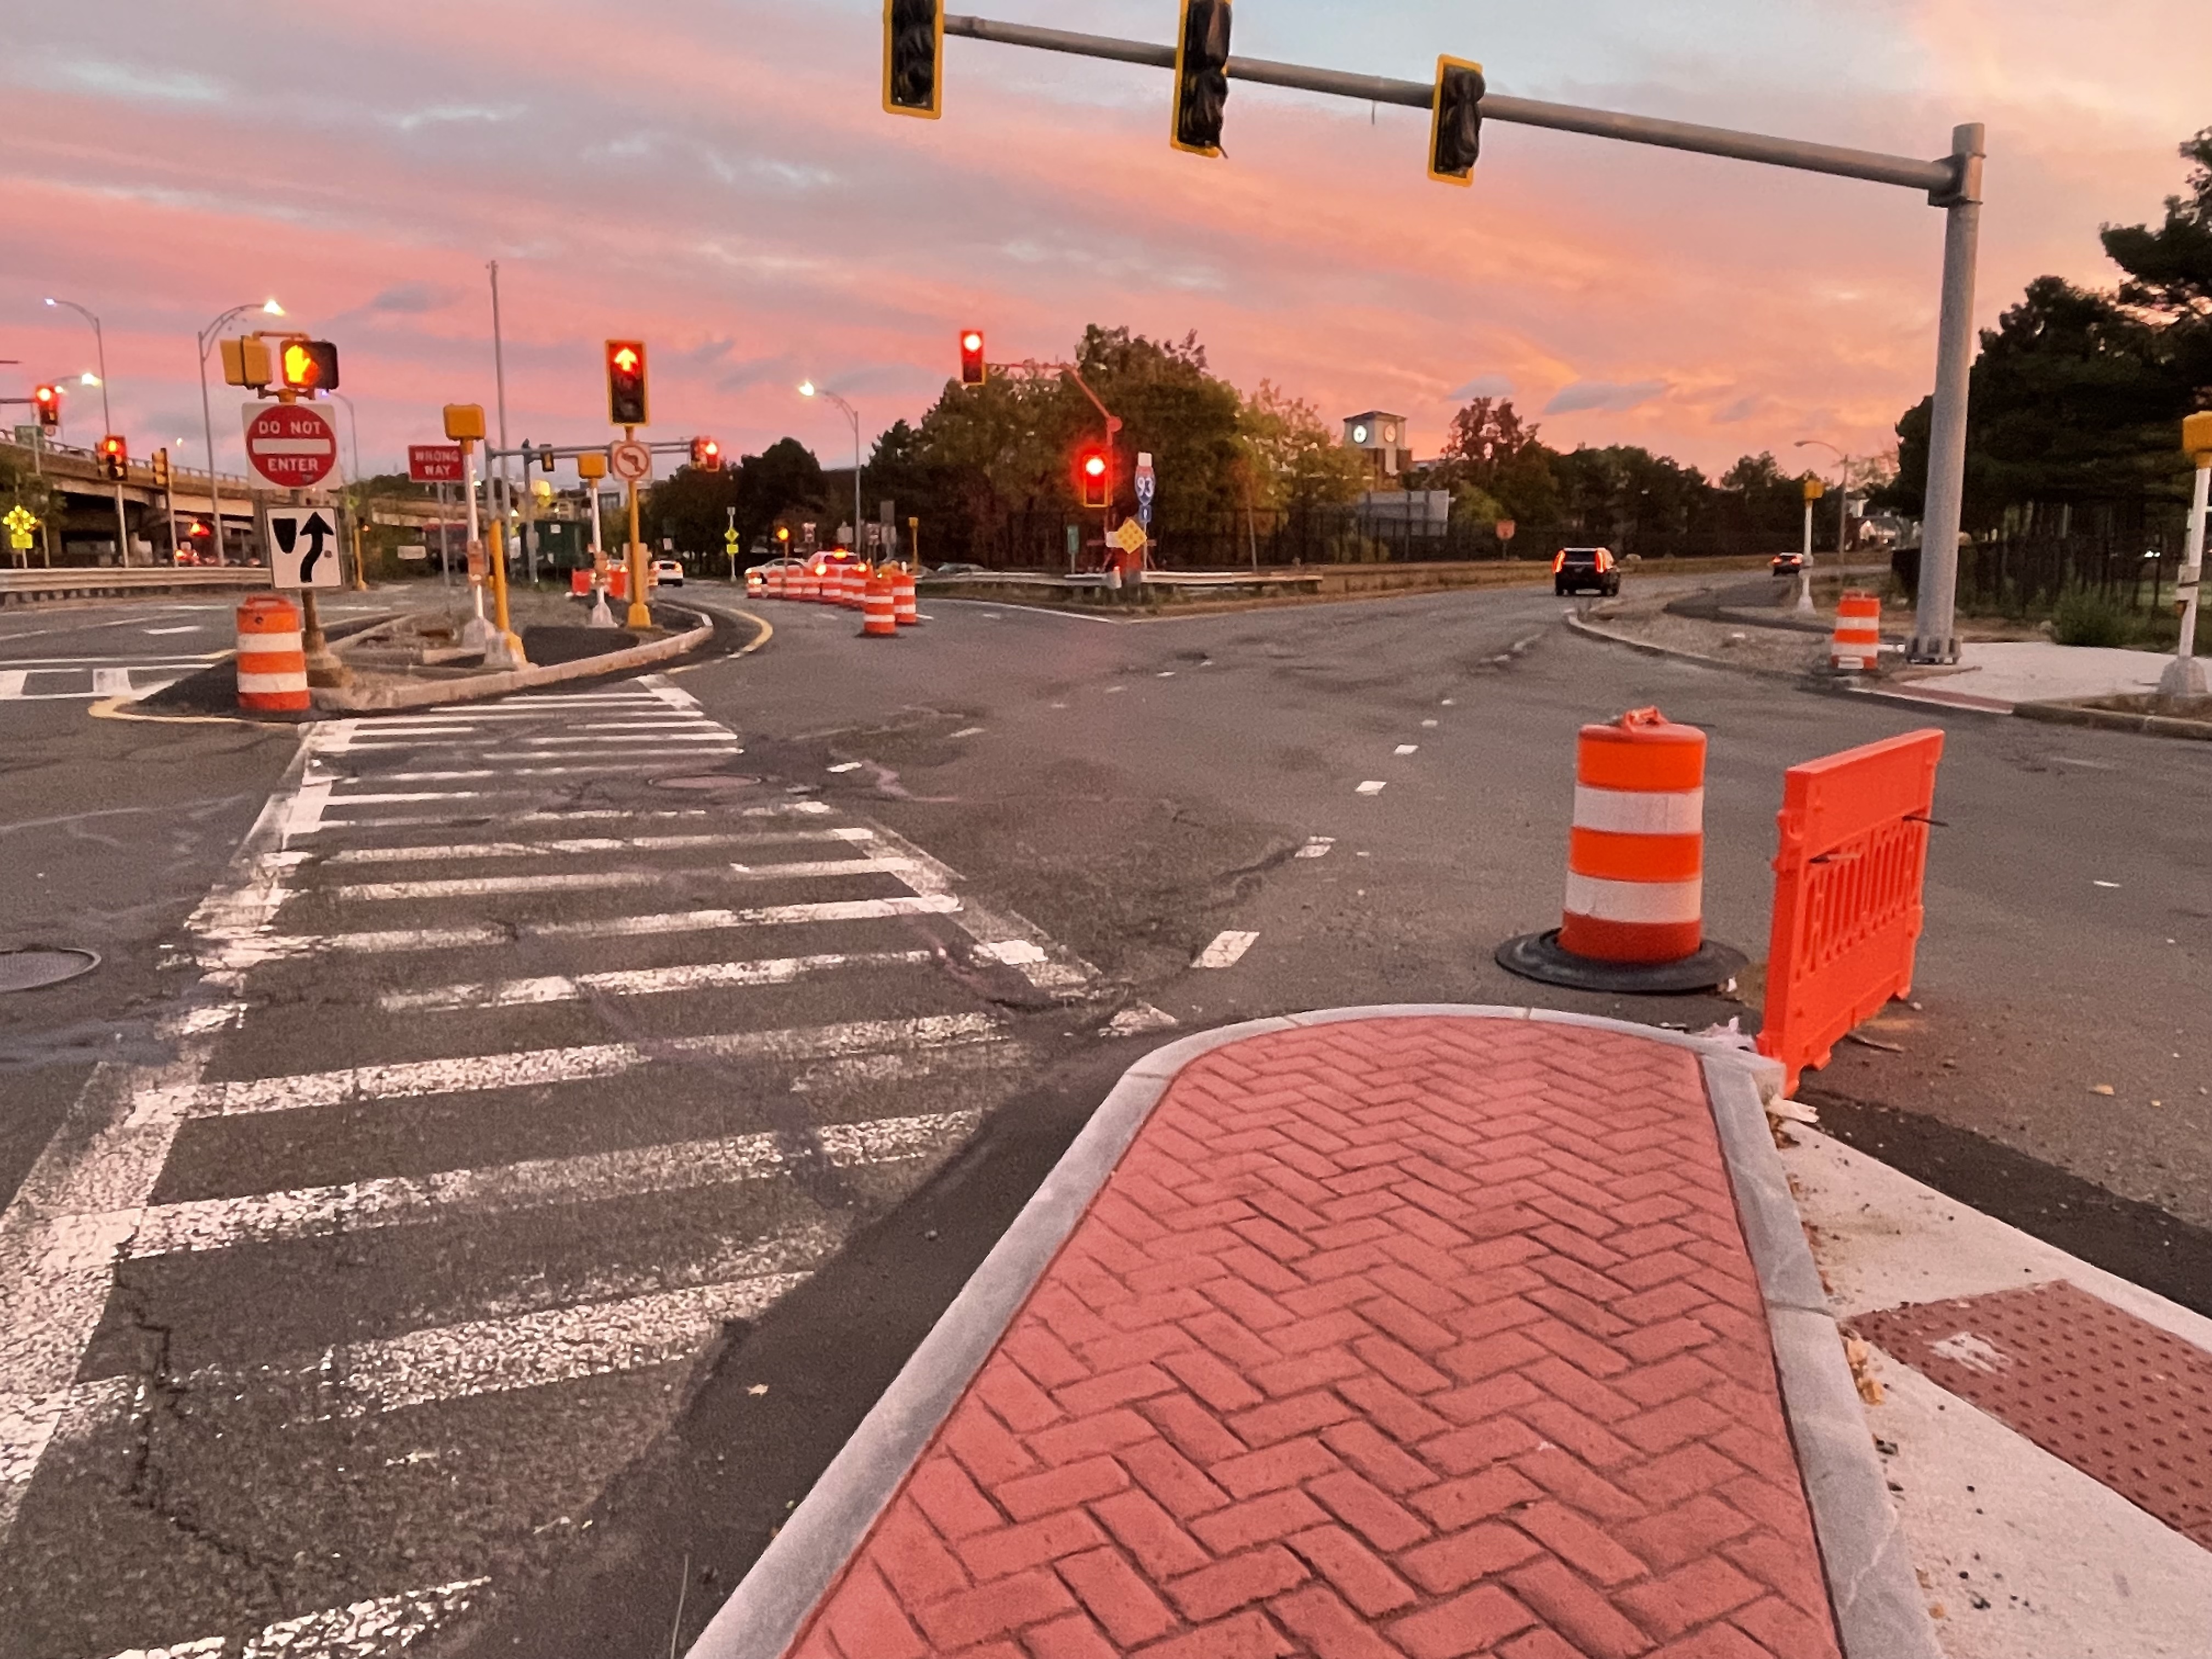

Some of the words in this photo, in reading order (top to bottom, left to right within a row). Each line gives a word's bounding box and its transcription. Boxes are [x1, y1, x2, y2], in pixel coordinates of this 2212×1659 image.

[259, 421, 281, 435] DO
[290, 421, 321, 435] NOT
[415, 450, 459, 462] WRONG
[268, 458, 319, 472] ENTER
[424, 465, 450, 476] WAY
[1137, 477, 1153, 497] 93
